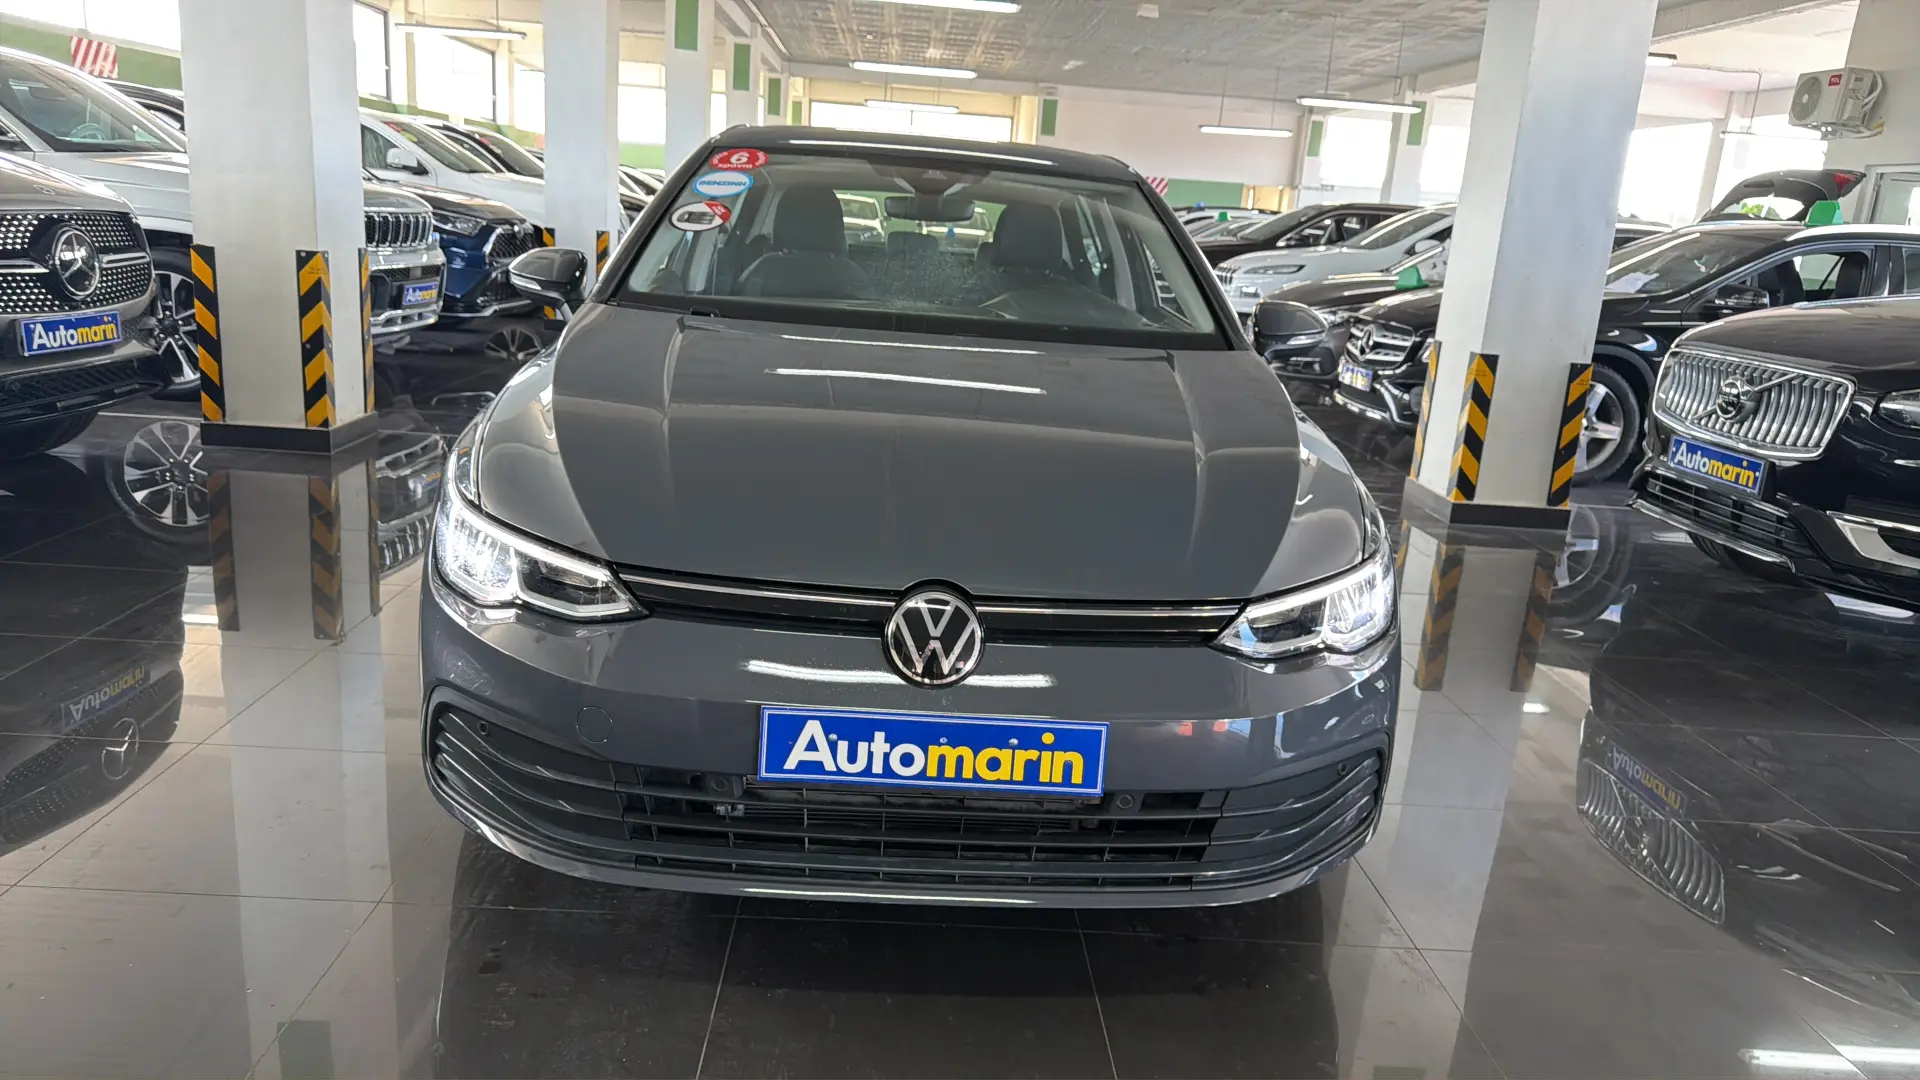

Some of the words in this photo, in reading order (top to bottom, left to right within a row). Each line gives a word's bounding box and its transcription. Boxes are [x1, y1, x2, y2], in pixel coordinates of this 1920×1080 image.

[729, 151, 750, 165] 6
[32, 315, 118, 350] Automarin
[1673, 441, 1755, 488] Automarin
[782, 719, 1085, 785] Automarin
